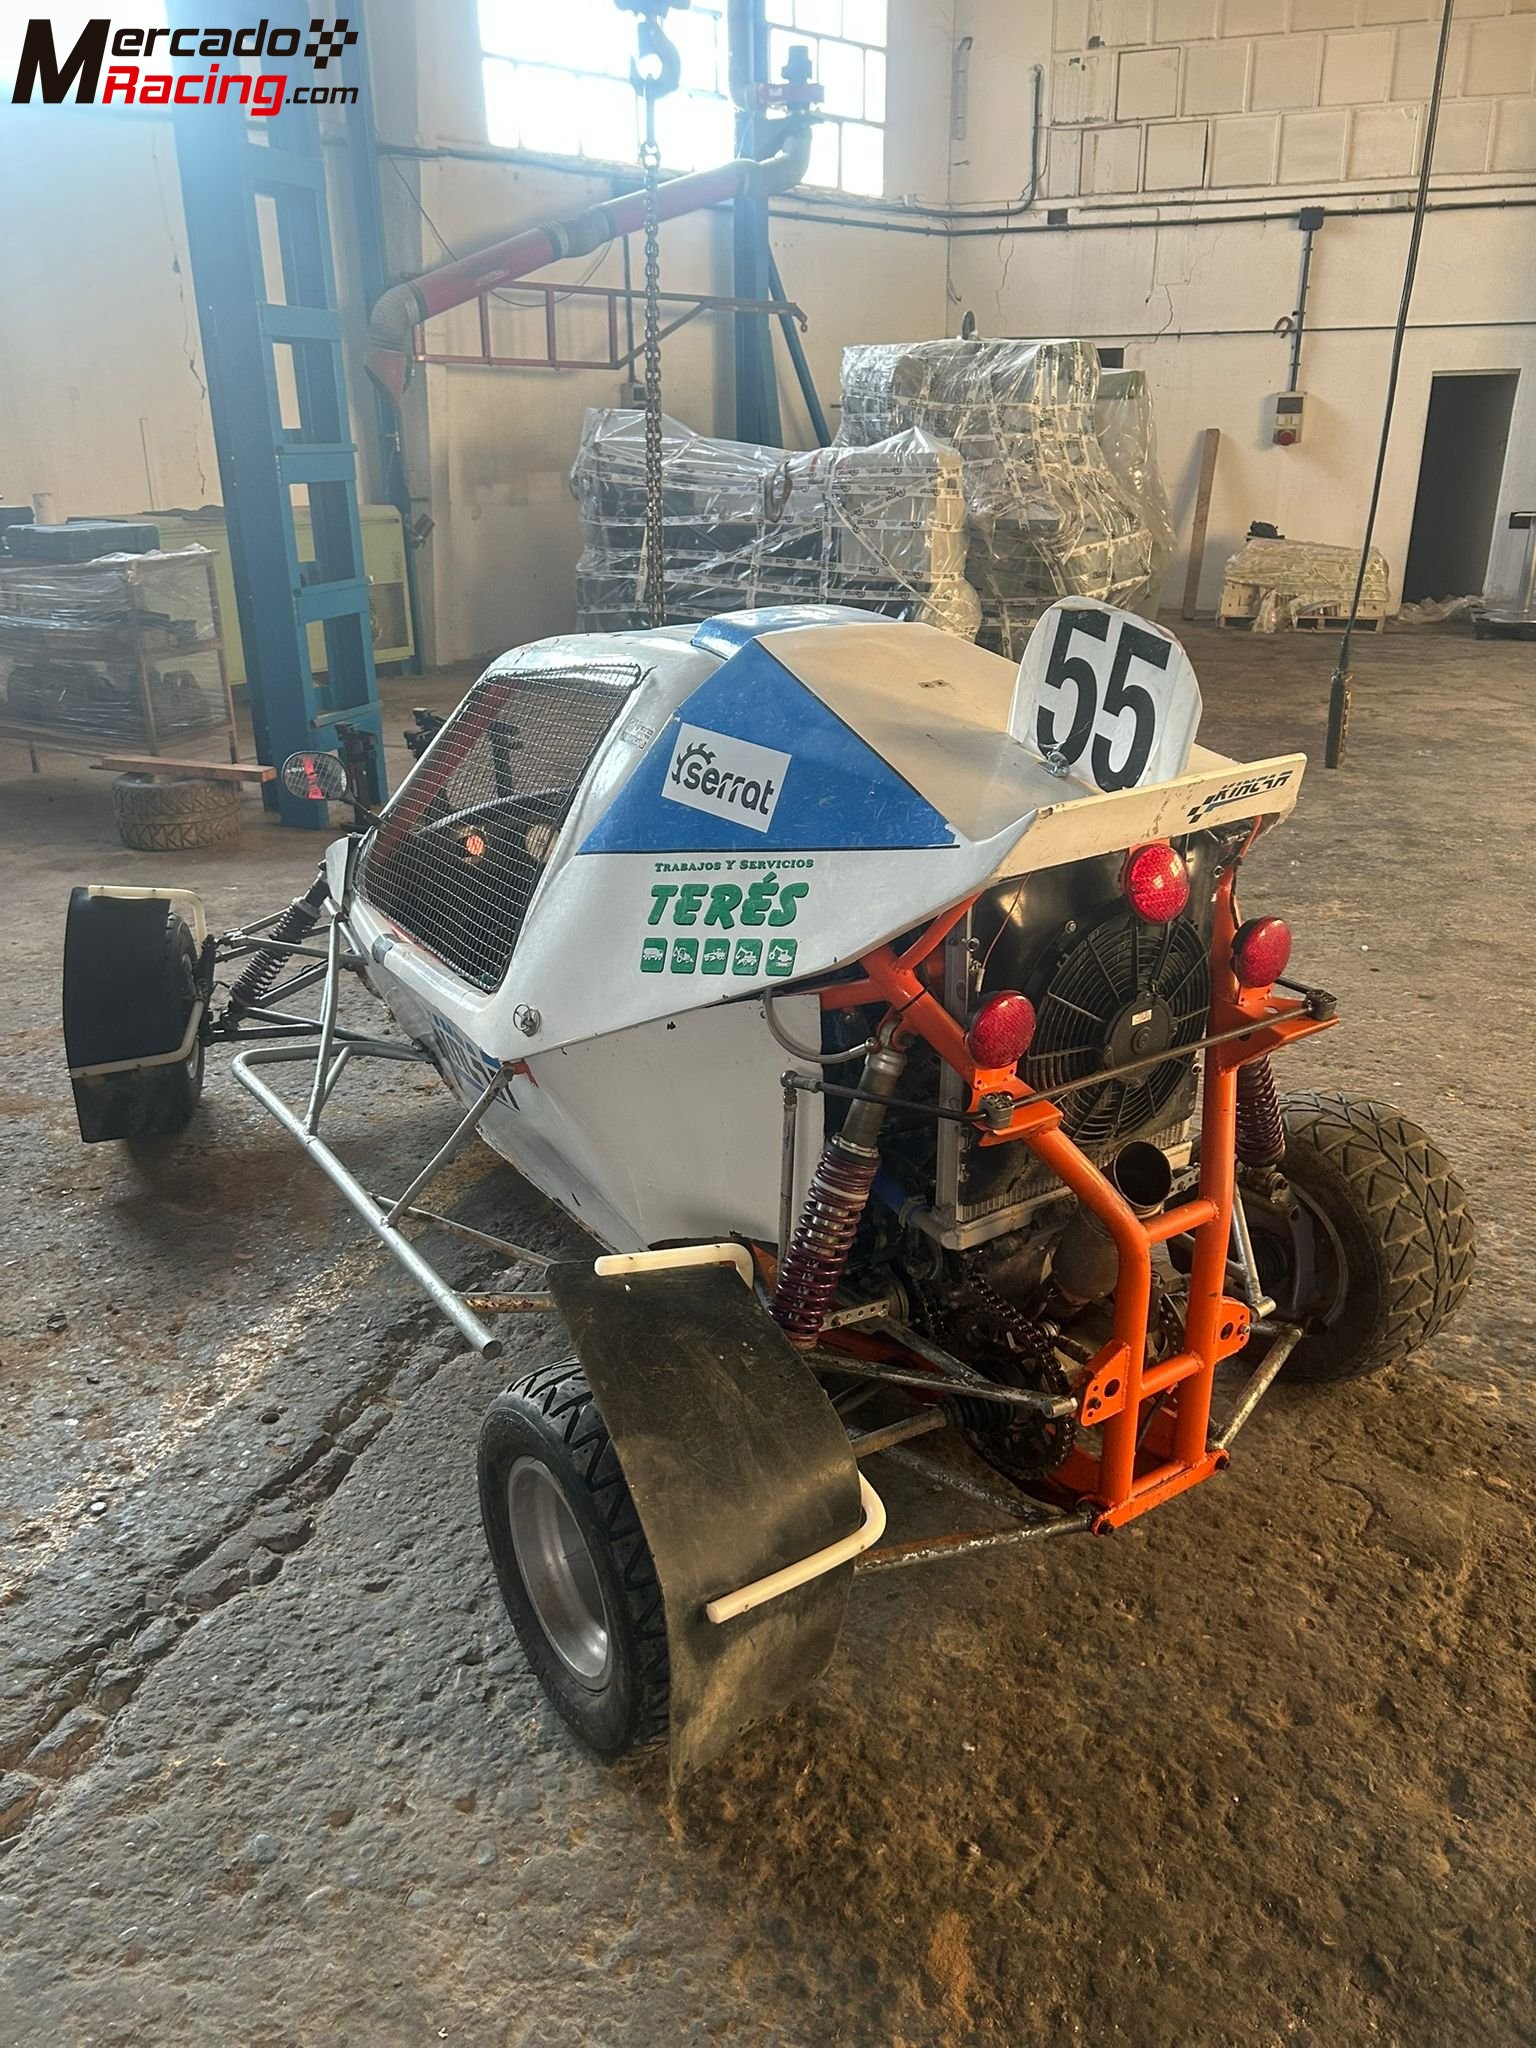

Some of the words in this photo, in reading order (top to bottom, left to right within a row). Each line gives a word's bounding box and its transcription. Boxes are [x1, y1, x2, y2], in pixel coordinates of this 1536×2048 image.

[1036, 609, 1172, 793] 55
[682, 756, 775, 815] serrat
[725, 860, 737, 871] Y
[647, 872, 809, 930] TERÉS
